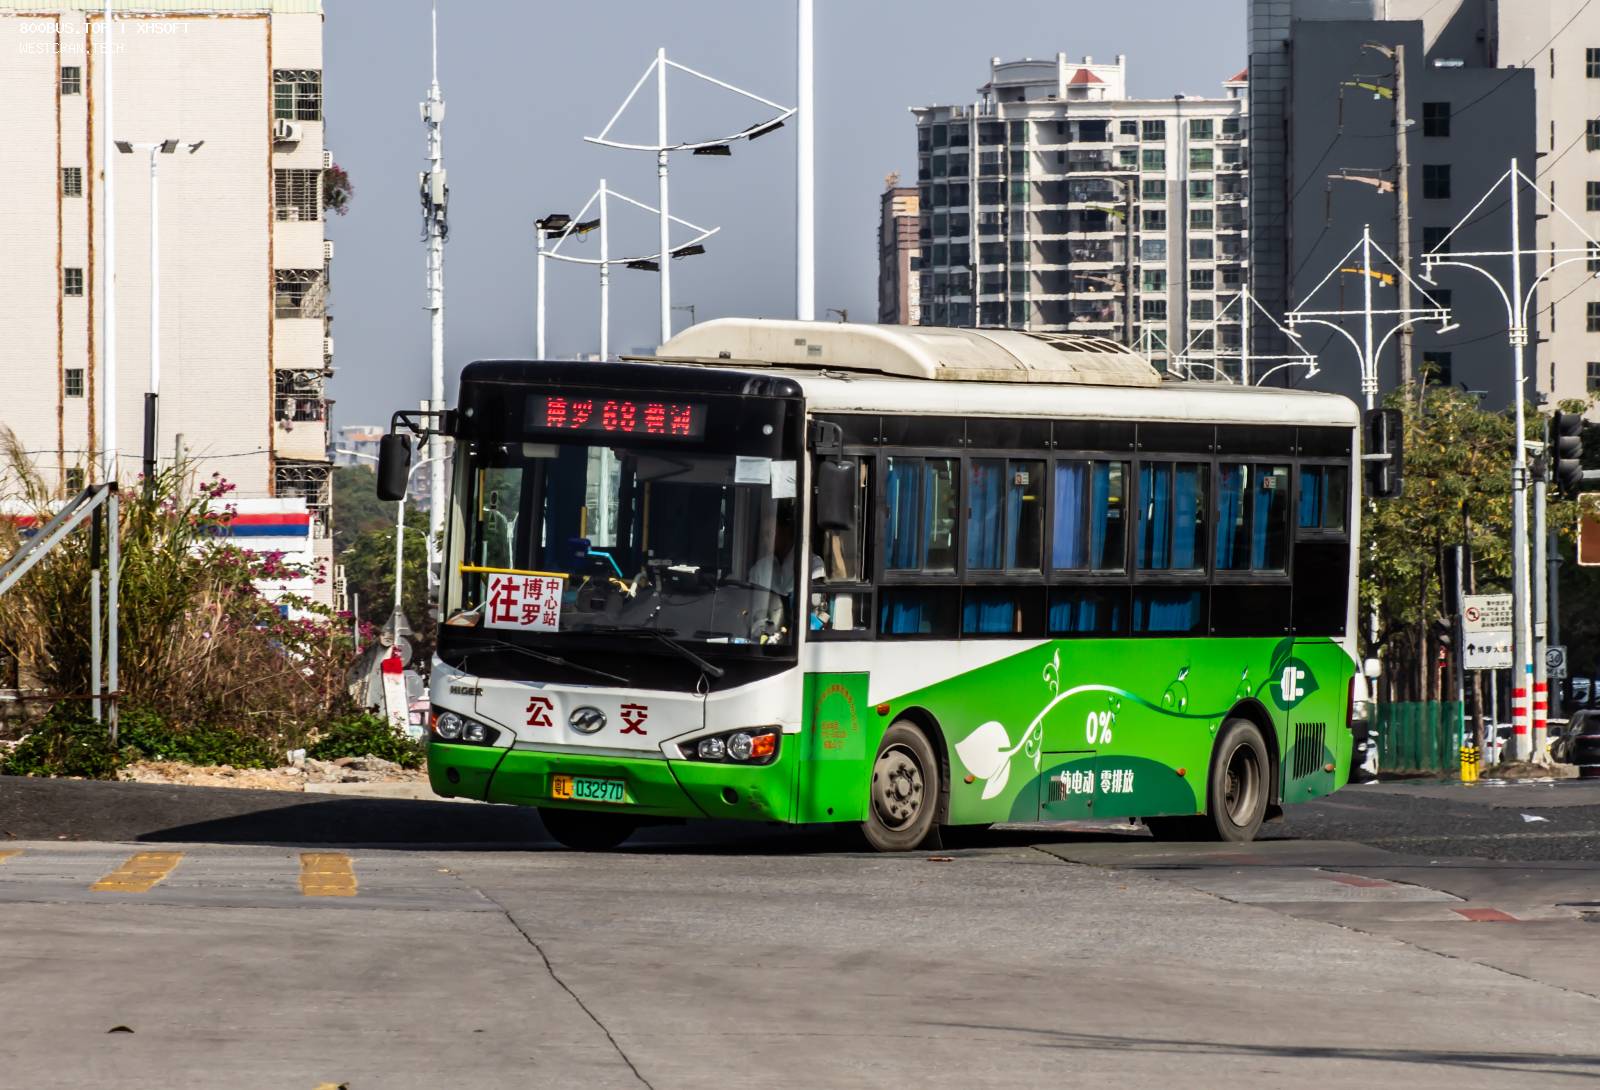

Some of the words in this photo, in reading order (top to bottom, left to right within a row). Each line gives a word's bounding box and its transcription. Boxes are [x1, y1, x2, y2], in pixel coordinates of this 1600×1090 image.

[603, 401, 636, 432] 68
[489, 576, 520, 624] 往
[520, 577, 544, 626] 博罗
[542, 578, 559, 627] 中心站
[449, 685, 484, 697] HIGER
[526, 696, 554, 728] 公
[620, 703, 648, 736] 交
[1086, 710, 1112, 745] 0%
[1060, 769, 1095, 795] 纯电动
[1100, 768, 1135, 794] 零排放
